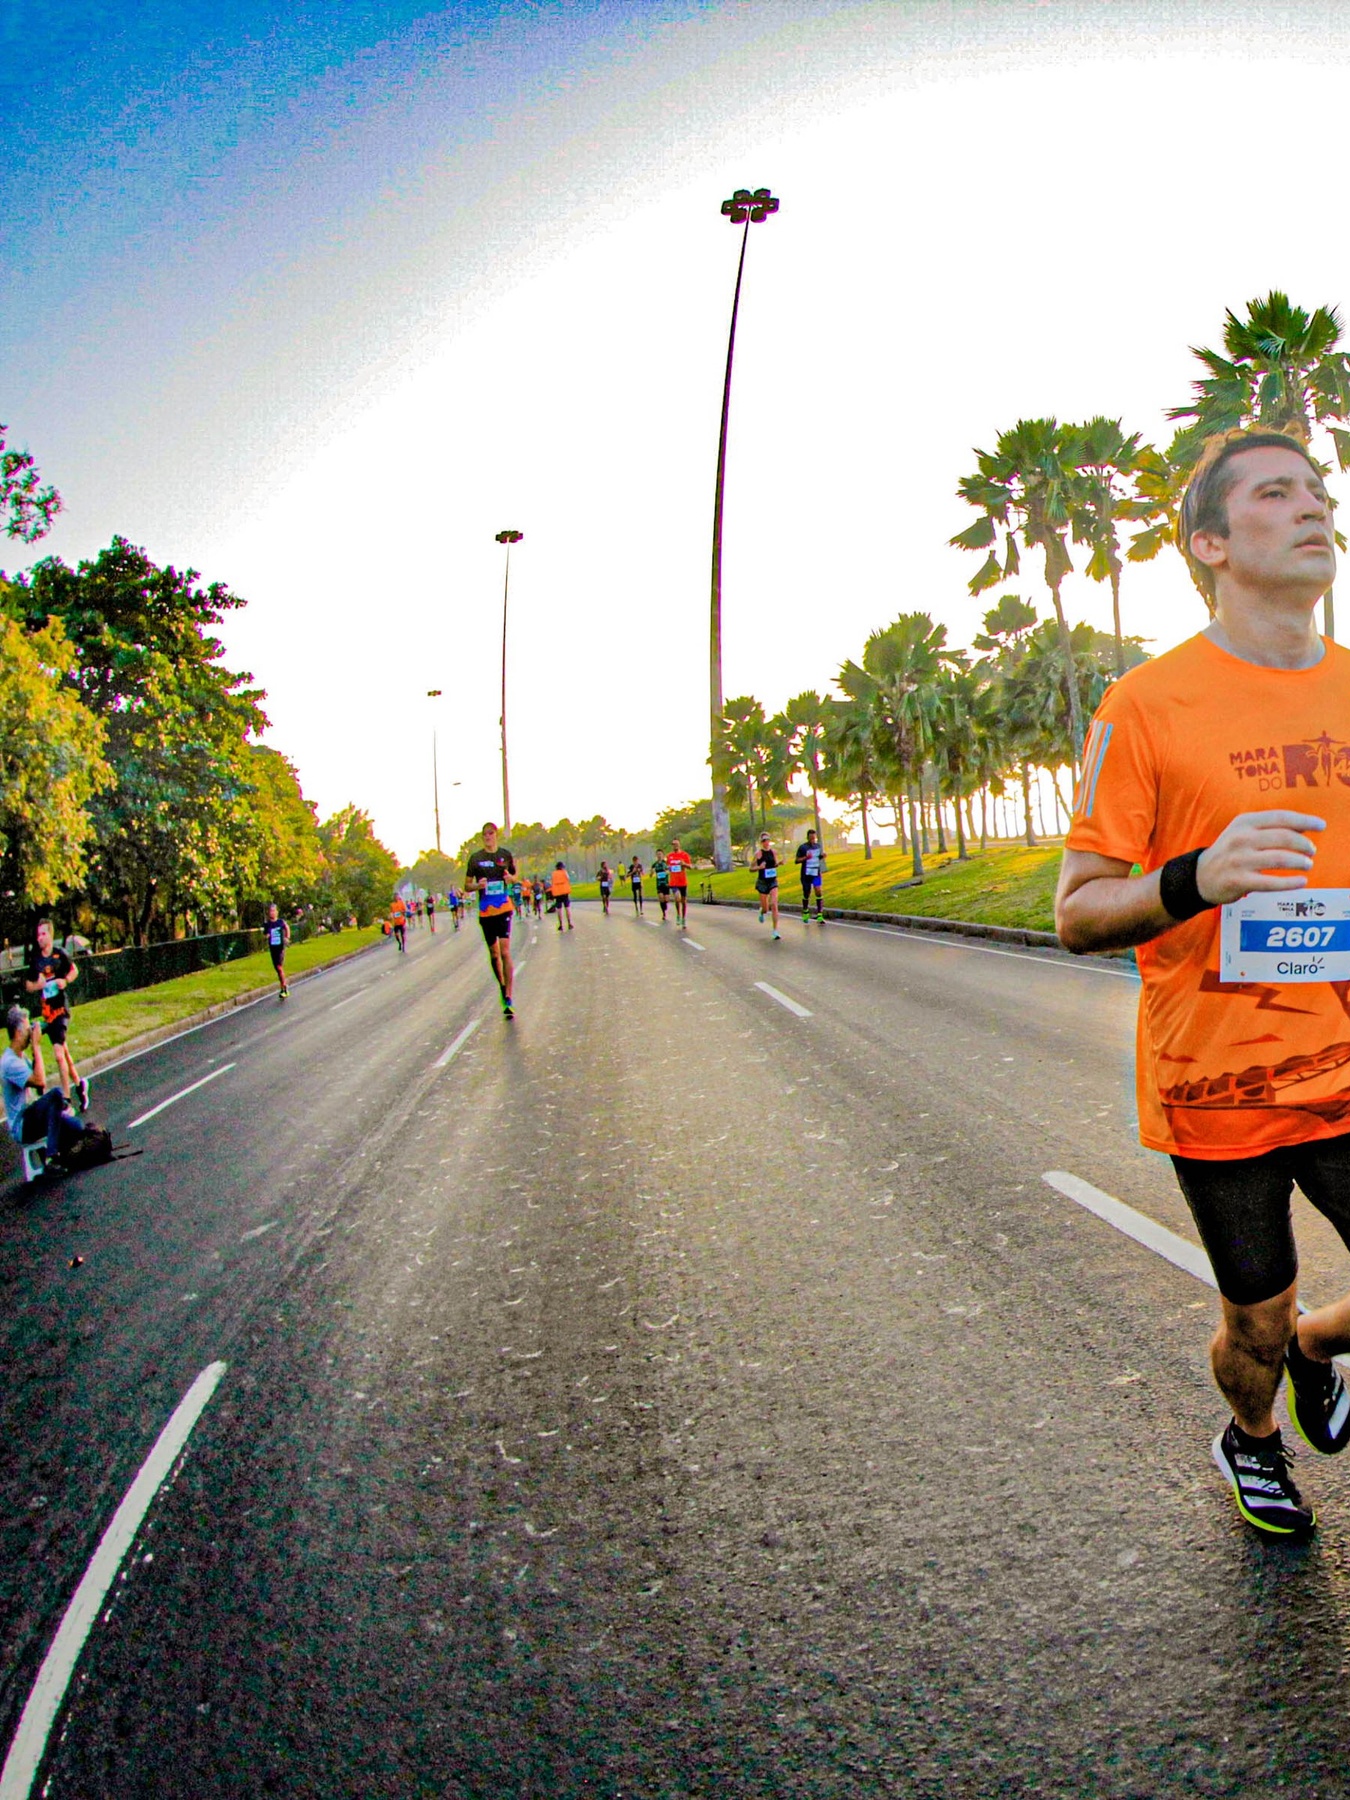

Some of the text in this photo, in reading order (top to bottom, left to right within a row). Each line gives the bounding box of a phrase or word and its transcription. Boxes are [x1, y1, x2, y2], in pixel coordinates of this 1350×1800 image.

[1229, 747, 1279, 765] MARA
[1235, 762, 1280, 780] TONA
[1259, 777, 1282, 792] DO
[1266, 926, 1336, 948] 2607
[1277, 961, 1318, 975] Claro
